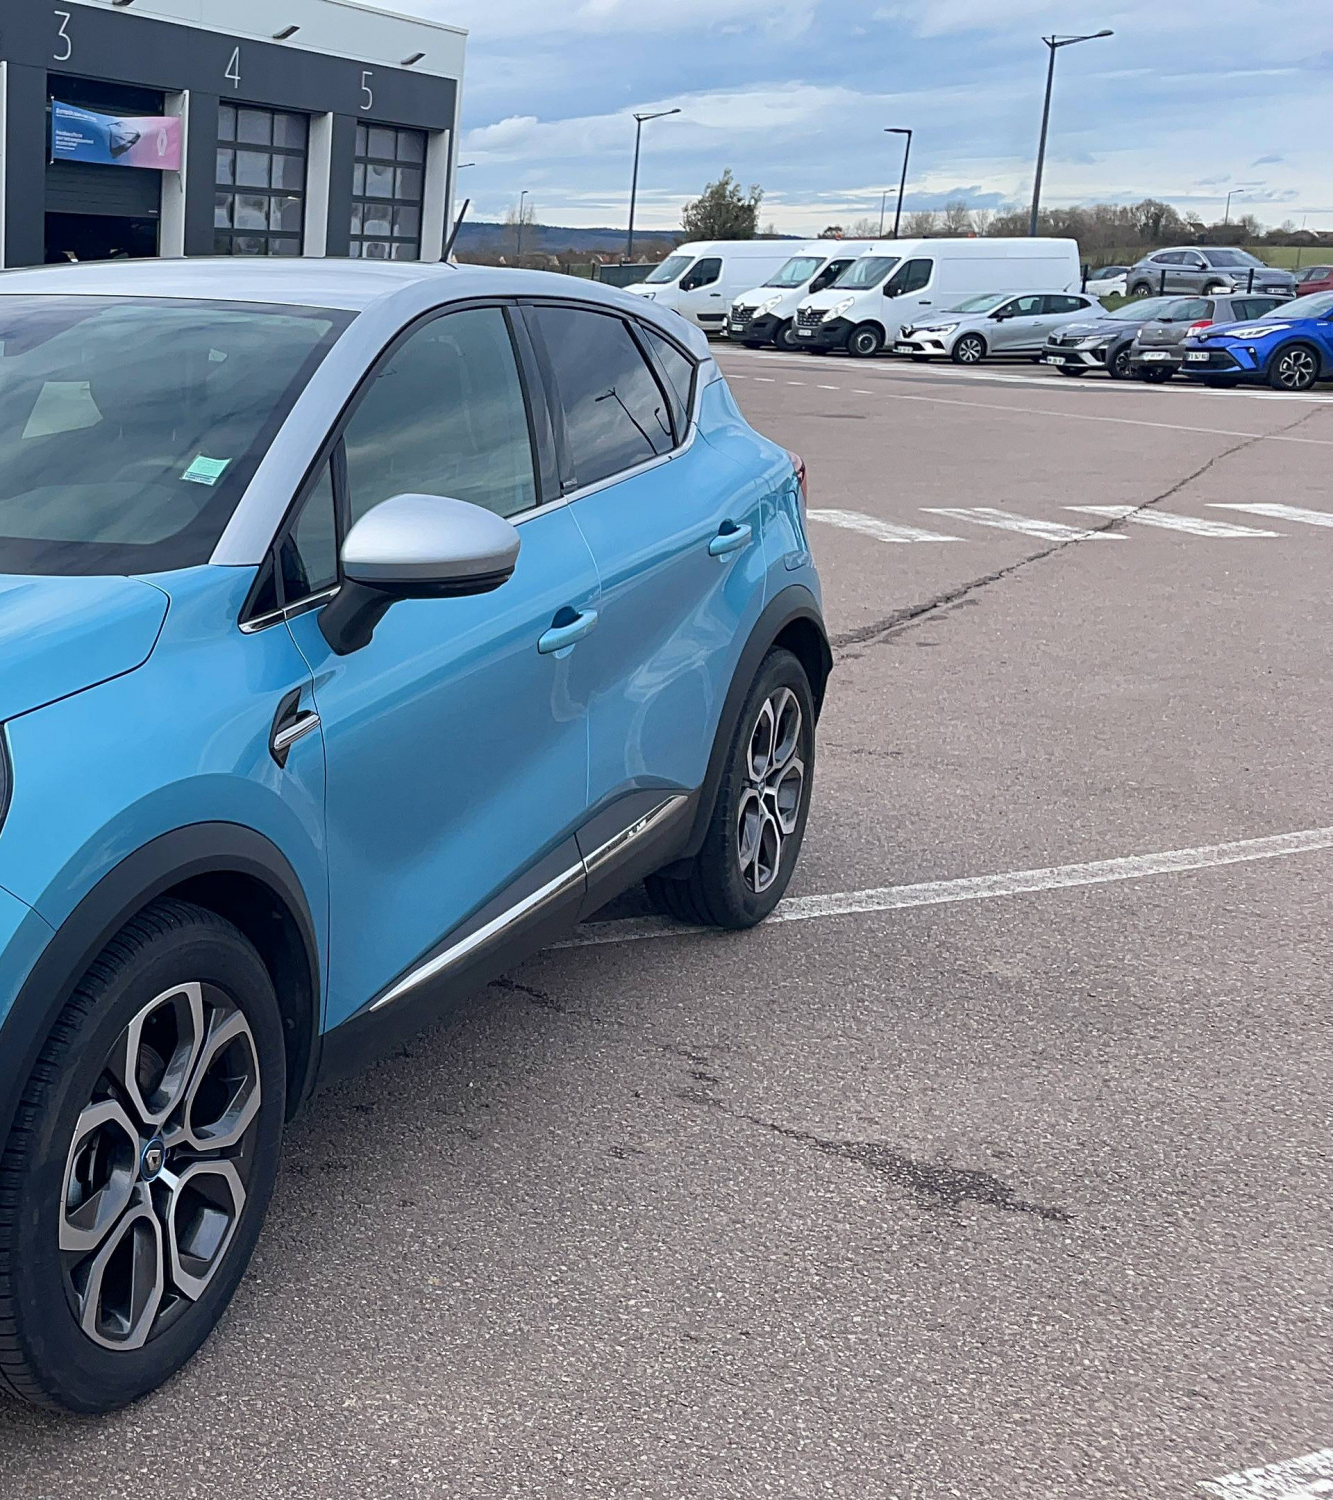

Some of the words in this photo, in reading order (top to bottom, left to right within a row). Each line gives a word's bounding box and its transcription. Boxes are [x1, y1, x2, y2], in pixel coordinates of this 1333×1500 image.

[53, 10, 72, 61] 3
[224, 46, 241, 89] 4
[360, 70, 373, 110] 5
